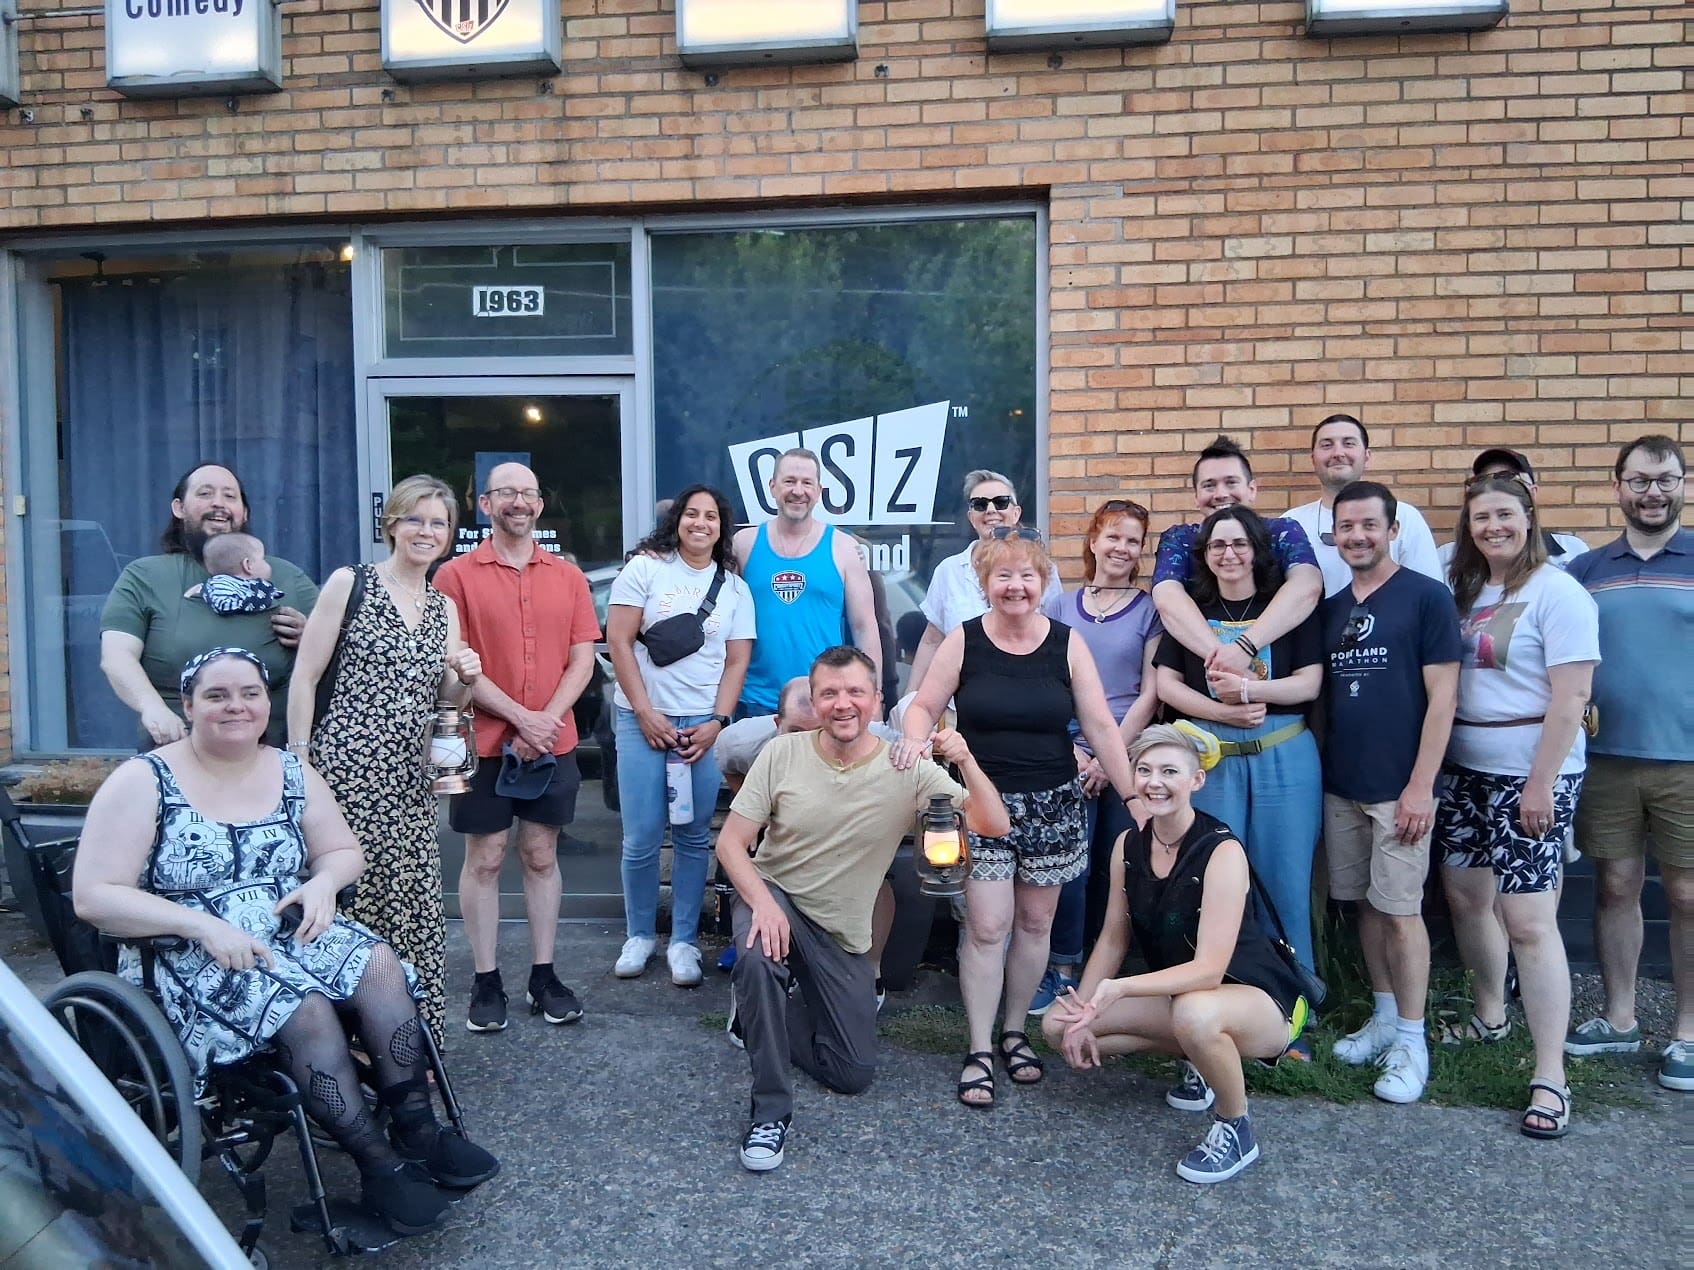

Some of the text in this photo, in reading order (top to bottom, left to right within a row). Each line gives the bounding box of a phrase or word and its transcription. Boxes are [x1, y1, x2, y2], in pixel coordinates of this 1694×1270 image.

[479, 290, 540, 313] 1963
[951, 406, 968, 418] TM
[373, 496, 382, 540] PULL
[458, 527, 479, 539] For
[455, 541, 479, 553] and
[1330, 646, 1388, 661] PORTLAND
[1331, 657, 1388, 668] MAATHON
[236, 889, 259, 902] VII
